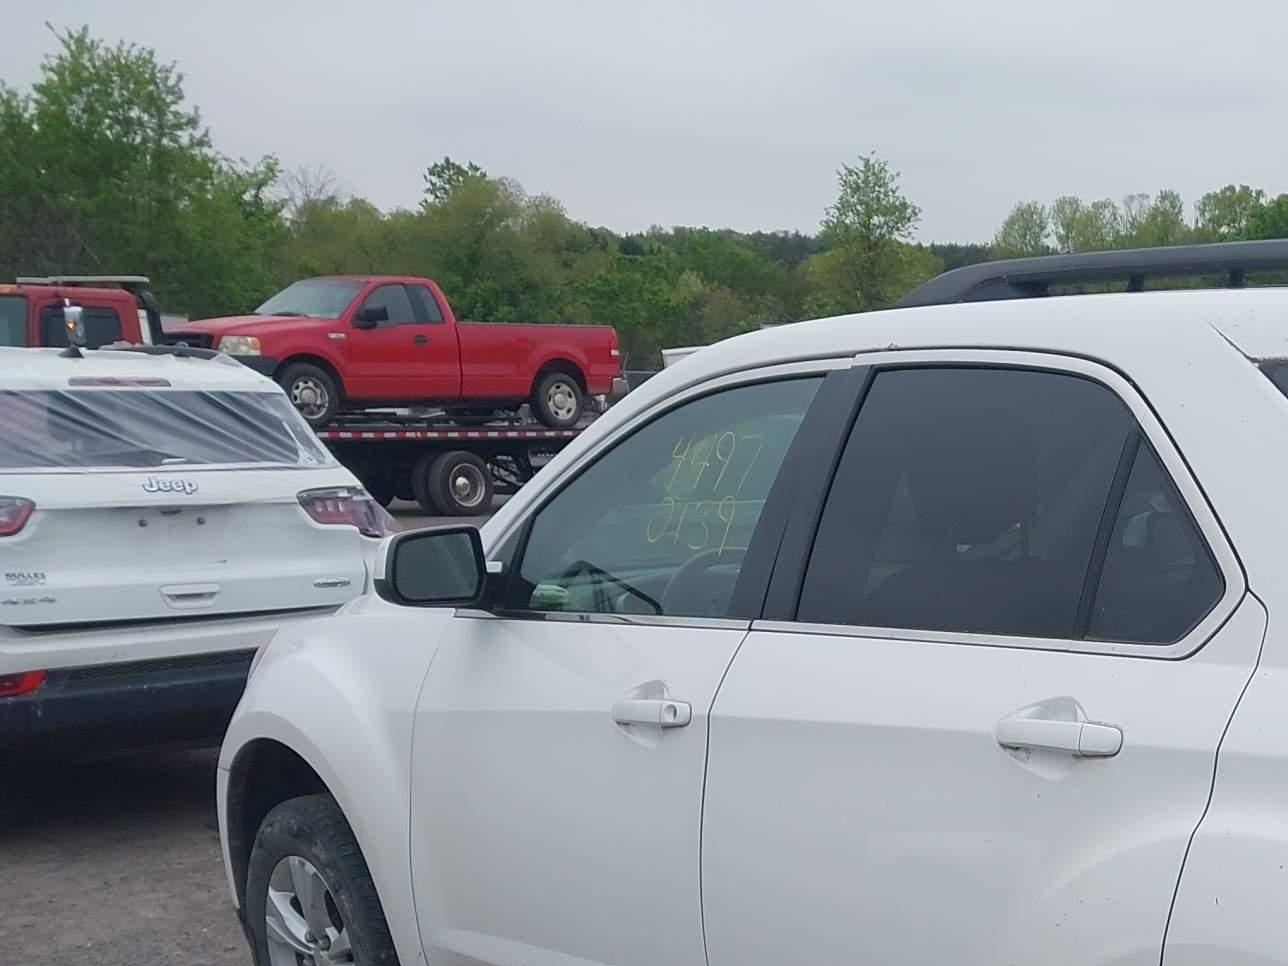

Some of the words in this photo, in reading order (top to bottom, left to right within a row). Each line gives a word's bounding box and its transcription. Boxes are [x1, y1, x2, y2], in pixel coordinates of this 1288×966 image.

[142, 476, 199, 495] Jeep
[665, 431, 764, 494] 4497
[646, 494, 736, 556] 0139
